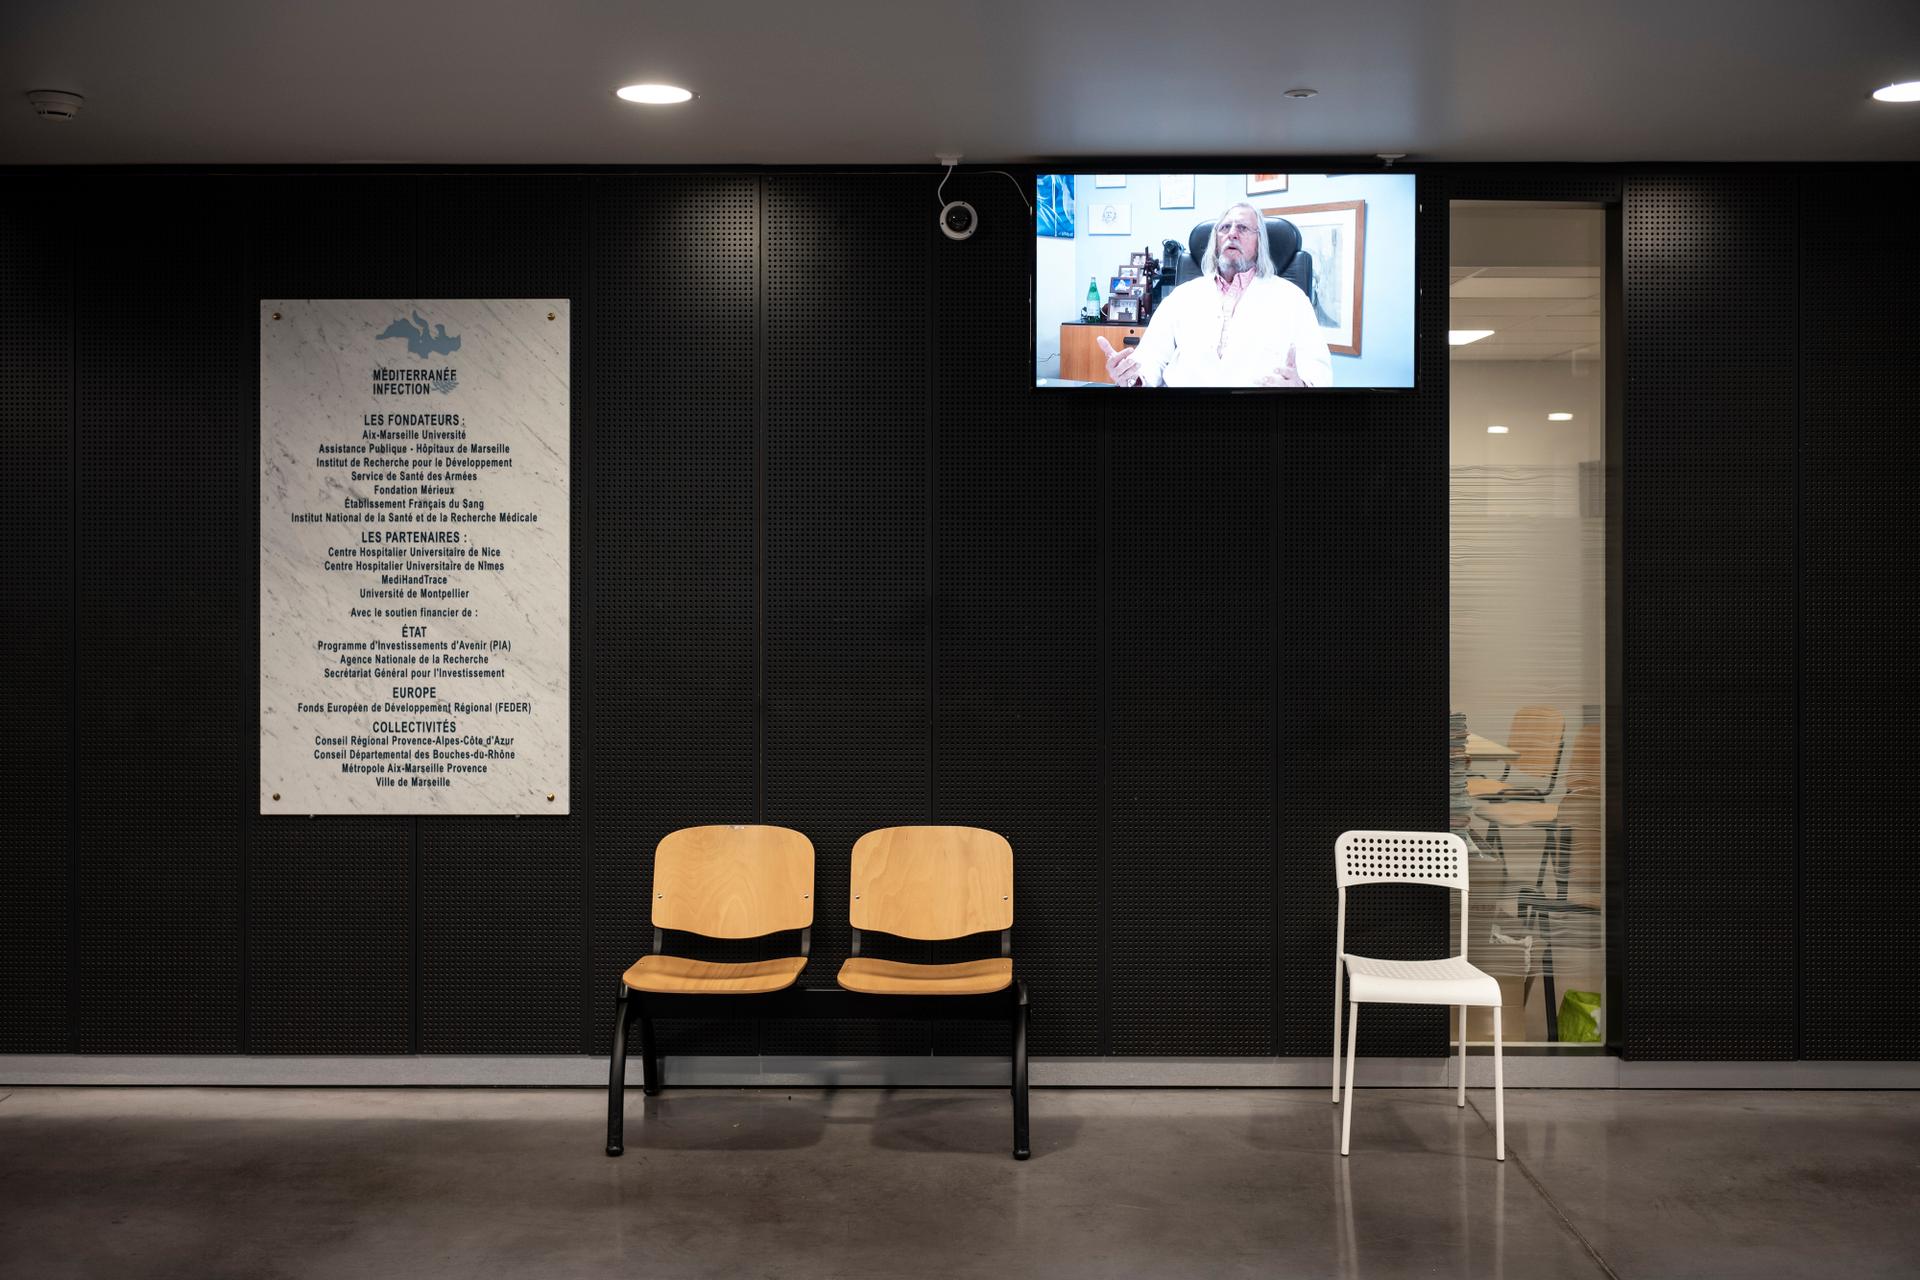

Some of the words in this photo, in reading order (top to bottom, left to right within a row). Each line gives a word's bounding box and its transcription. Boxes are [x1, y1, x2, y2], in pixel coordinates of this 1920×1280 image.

[373, 384, 430, 394] INFECTION
[364, 415, 384, 426] LES
[388, 415, 459, 426] FONDATEURS
[362, 430, 419, 440] Aix-Marseille
[422, 430, 466, 440] Université
[319, 444, 366, 454] Assistance
[369, 444, 407, 455] Publique
[416, 444, 454, 455] Hôpitaux
[457, 444, 467, 454] de
[470, 444, 510, 454] Marseille
[316, 458, 347, 467] Institut
[350, 458, 360, 467] de
[363, 458, 409, 467] Recherche
[412, 458, 431, 469] pour
[435, 458, 442, 467] le
[445, 458, 512, 469] Développement
[351, 472, 383, 481] Service
[386, 472, 396, 481] de
[400, 472, 424, 481] Santé
[427, 472, 442, 481] des
[445, 472, 477, 481] Armées
[374, 485, 417, 495] Fondation
[420, 485, 455, 495] Mérieux
[344, 498, 405, 508] Établissement
[408, 500, 445, 510] Français
[449, 500, 459, 508] du
[462, 500, 484, 510] Sang
[291, 513, 322, 523] Institut
[325, 513, 361, 523] National
[364, 513, 374, 523] de
[377, 513, 385, 523] la
[388, 513, 412, 523] Santé
[416, 513, 424, 523] et
[426, 513, 436, 523] de
[440, 513, 448, 523] la
[450, 513, 496, 523] Recherche
[499, 513, 538, 523] Médicale
[362, 532, 381, 543] LES
[385, 532, 459, 543] PARTENAIRES
[328, 547, 356, 557] Centre
[360, 547, 406, 558] Hospitalier
[410, 547, 465, 557] Universitaire
[468, 547, 478, 557] de
[481, 547, 501, 557] Nice
[324, 561, 353, 570] Centre
[356, 561, 402, 572] Hospitalier
[406, 561, 461, 570] Universitaire
[464, 561, 475, 570] de
[478, 561, 504, 570] Nîmes
[382, 575, 448, 584] MediHandTrace
[359, 589, 404, 598] Université
[407, 589, 417, 598] de
[420, 589, 469, 600] Montpellier
[351, 608, 371, 617] Avec
[374, 608, 382, 617] le
[385, 608, 417, 617] soutien
[420, 608, 458, 617] financier
[462, 608, 472, 617] de
[402, 624, 427, 637] ÉTAT
[318, 641, 367, 652] Programme
[370, 641, 448, 651] d'Investissements
[451, 641, 487, 651] d'Avenir
[489, 641, 511, 652] (PIA)
[340, 655, 372, 666] Agence
[375, 655, 416, 664] Nationale
[419, 655, 429, 664] de
[432, 655, 440, 664] la
[443, 655, 489, 664] Recherche
[324, 668, 371, 678] Secrétariat
[374, 668, 408, 678] Général
[411, 668, 430, 680] pour
[434, 668, 505, 678] l'Investissement
[392, 687, 436, 698] EUROPE
[297, 703, 324, 713] Fonds
[327, 703, 368, 715] Européen
[371, 703, 381, 713] de
[384, 703, 451, 715] Développement
[454, 703, 492, 715] Régional
[495, 703, 531, 714] (FEDER)
[372, 720, 456, 733] COLLECTIVITÉS
[315, 736, 348, 745] Conseil
[350, 736, 388, 747] Régional
[392, 736, 483, 747] Provence-Alpes-Côte
[486, 736, 514, 745] d'Azur
[314, 750, 346, 759] Conseil
[349, 750, 411, 761] Départemental
[414, 750, 429, 759] des
[433, 750, 515, 759] Bouches-du-Rhône
[342, 764, 384, 775] Métropole
[387, 764, 444, 773] Aix-Marseille
[447, 764, 487, 773] Provence
[376, 777, 395, 787] Ville
[398, 777, 408, 787] de
[411, 777, 450, 787] Marseille
